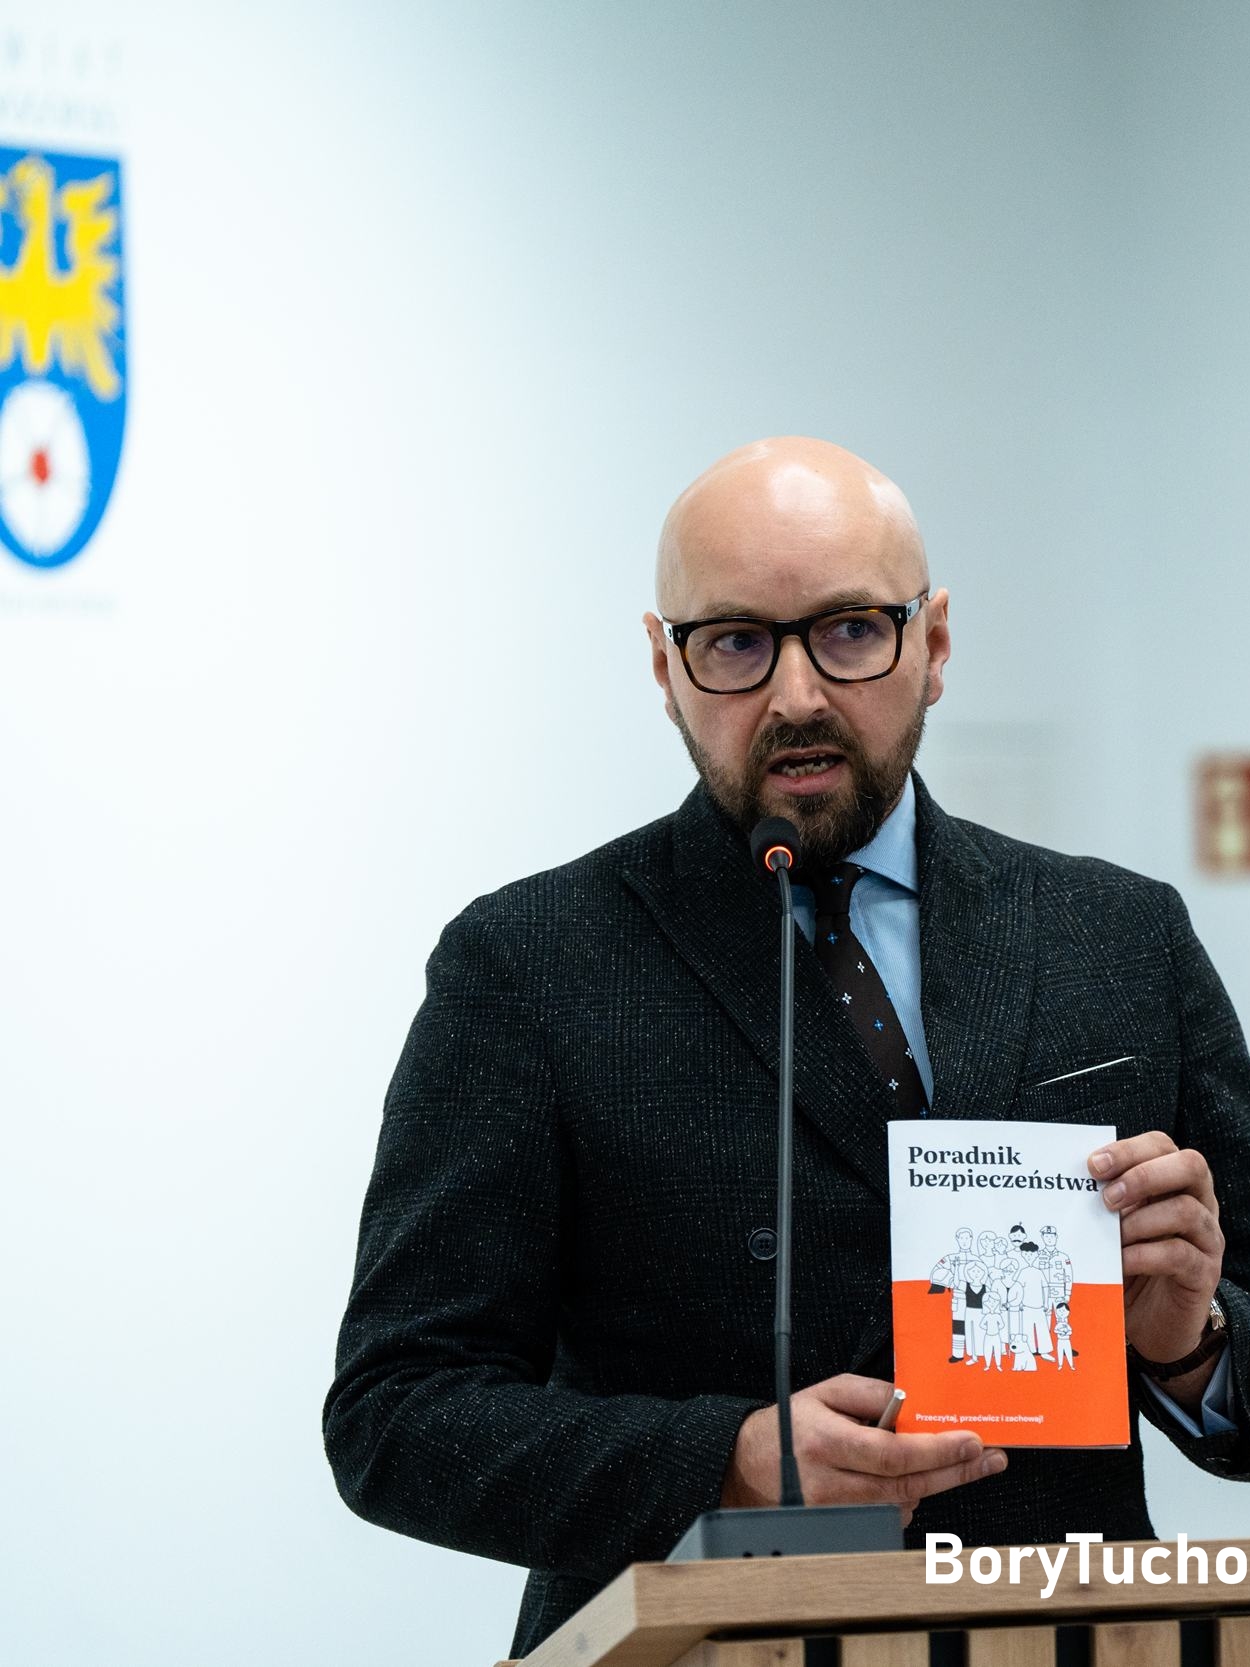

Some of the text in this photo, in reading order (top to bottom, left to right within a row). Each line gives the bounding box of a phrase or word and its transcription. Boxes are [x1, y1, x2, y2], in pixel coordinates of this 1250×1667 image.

[908, 1145, 1022, 1165] Poradnik
[908, 1168, 1099, 1192] bezpieczeństwa
[915, 1413, 959, 1424] Przeczytaj,
[960, 1414, 1000, 1424] przećwicz
[1005, 1414, 1044, 1424] zachowaj!
